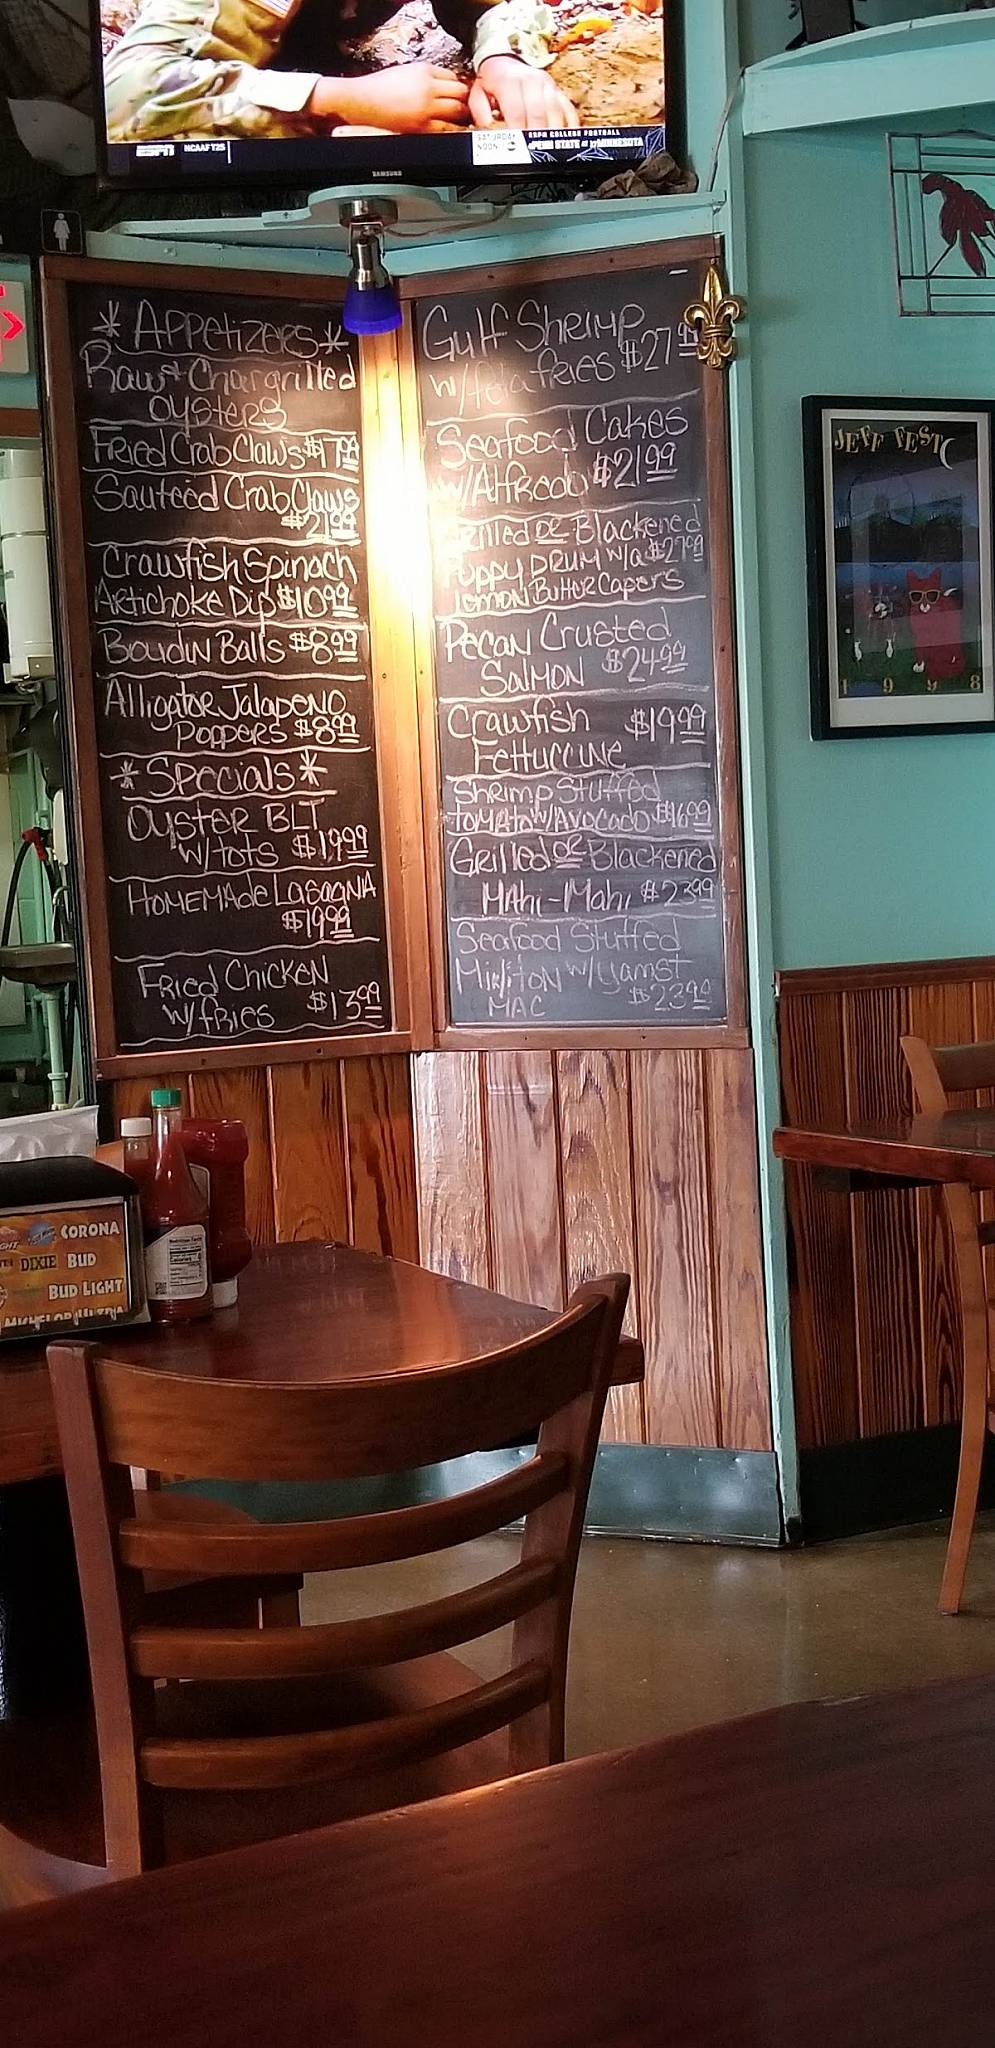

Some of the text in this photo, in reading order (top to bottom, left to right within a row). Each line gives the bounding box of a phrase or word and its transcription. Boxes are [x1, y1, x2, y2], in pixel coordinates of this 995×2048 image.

[423, 302, 509, 361] Gulf
[435, 410, 578, 469] Seafood
[834, 424, 944, 454] JEFF FEST
[447, 698, 590, 739] Crawfish
[262, 798, 325, 832] BLT
[456, 921, 561, 954] Seafood
[60, 1221, 120, 1240] CORONA
[20, 1255, 58, 1272] DIXIE
[67, 1252, 97, 1269] BUD
[48, 1279, 124, 1301] BUD LIGHT
